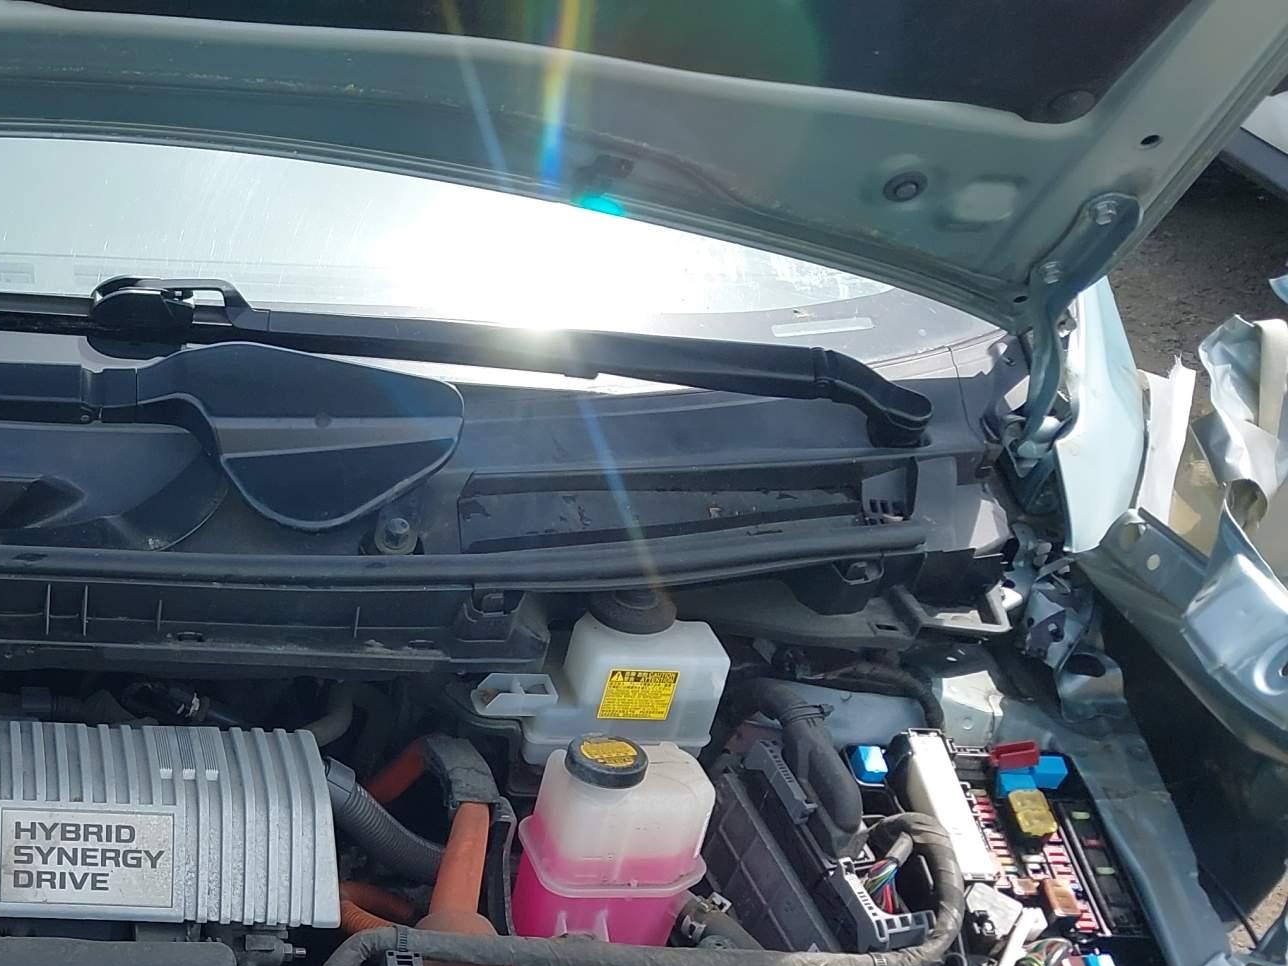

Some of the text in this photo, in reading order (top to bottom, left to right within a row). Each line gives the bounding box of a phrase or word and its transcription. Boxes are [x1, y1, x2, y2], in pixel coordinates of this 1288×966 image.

[14, 821, 136, 843] HYBRID
[13, 845, 165, 869] SYNERGY
[13, 869, 109, 891] DRIVE
